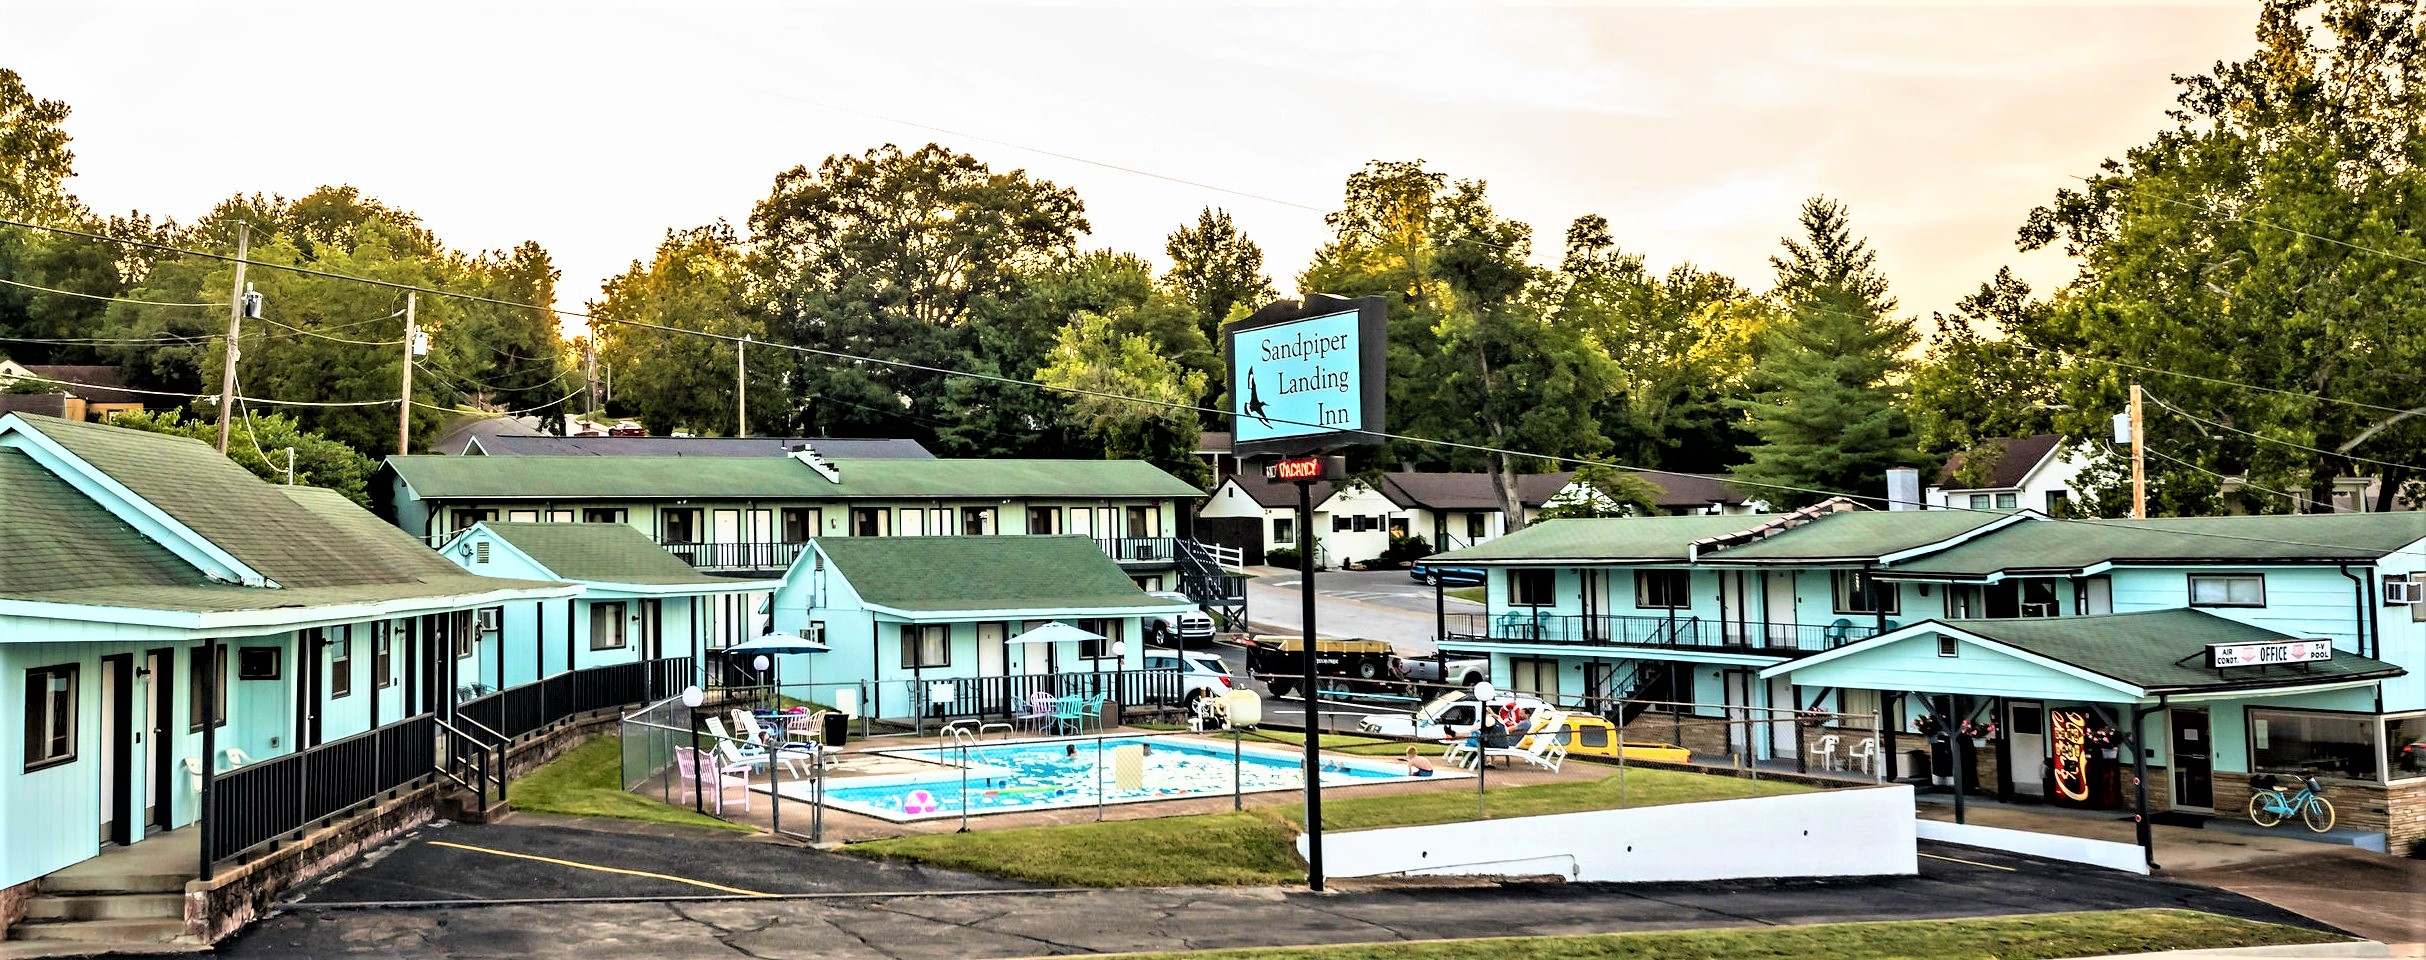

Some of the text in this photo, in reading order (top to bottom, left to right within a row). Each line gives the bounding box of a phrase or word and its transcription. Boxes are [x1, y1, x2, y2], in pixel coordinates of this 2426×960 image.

[1261, 332, 1348, 362] Sandpiper
[1278, 365, 1349, 395] Landing
[1318, 402, 1350, 426] Inn
[1278, 458, 1317, 478] VACANCY
[2221, 648, 2233, 656] AIR
[2260, 646, 2287, 662] OFFICE
[2310, 651, 2329, 659] POOL
